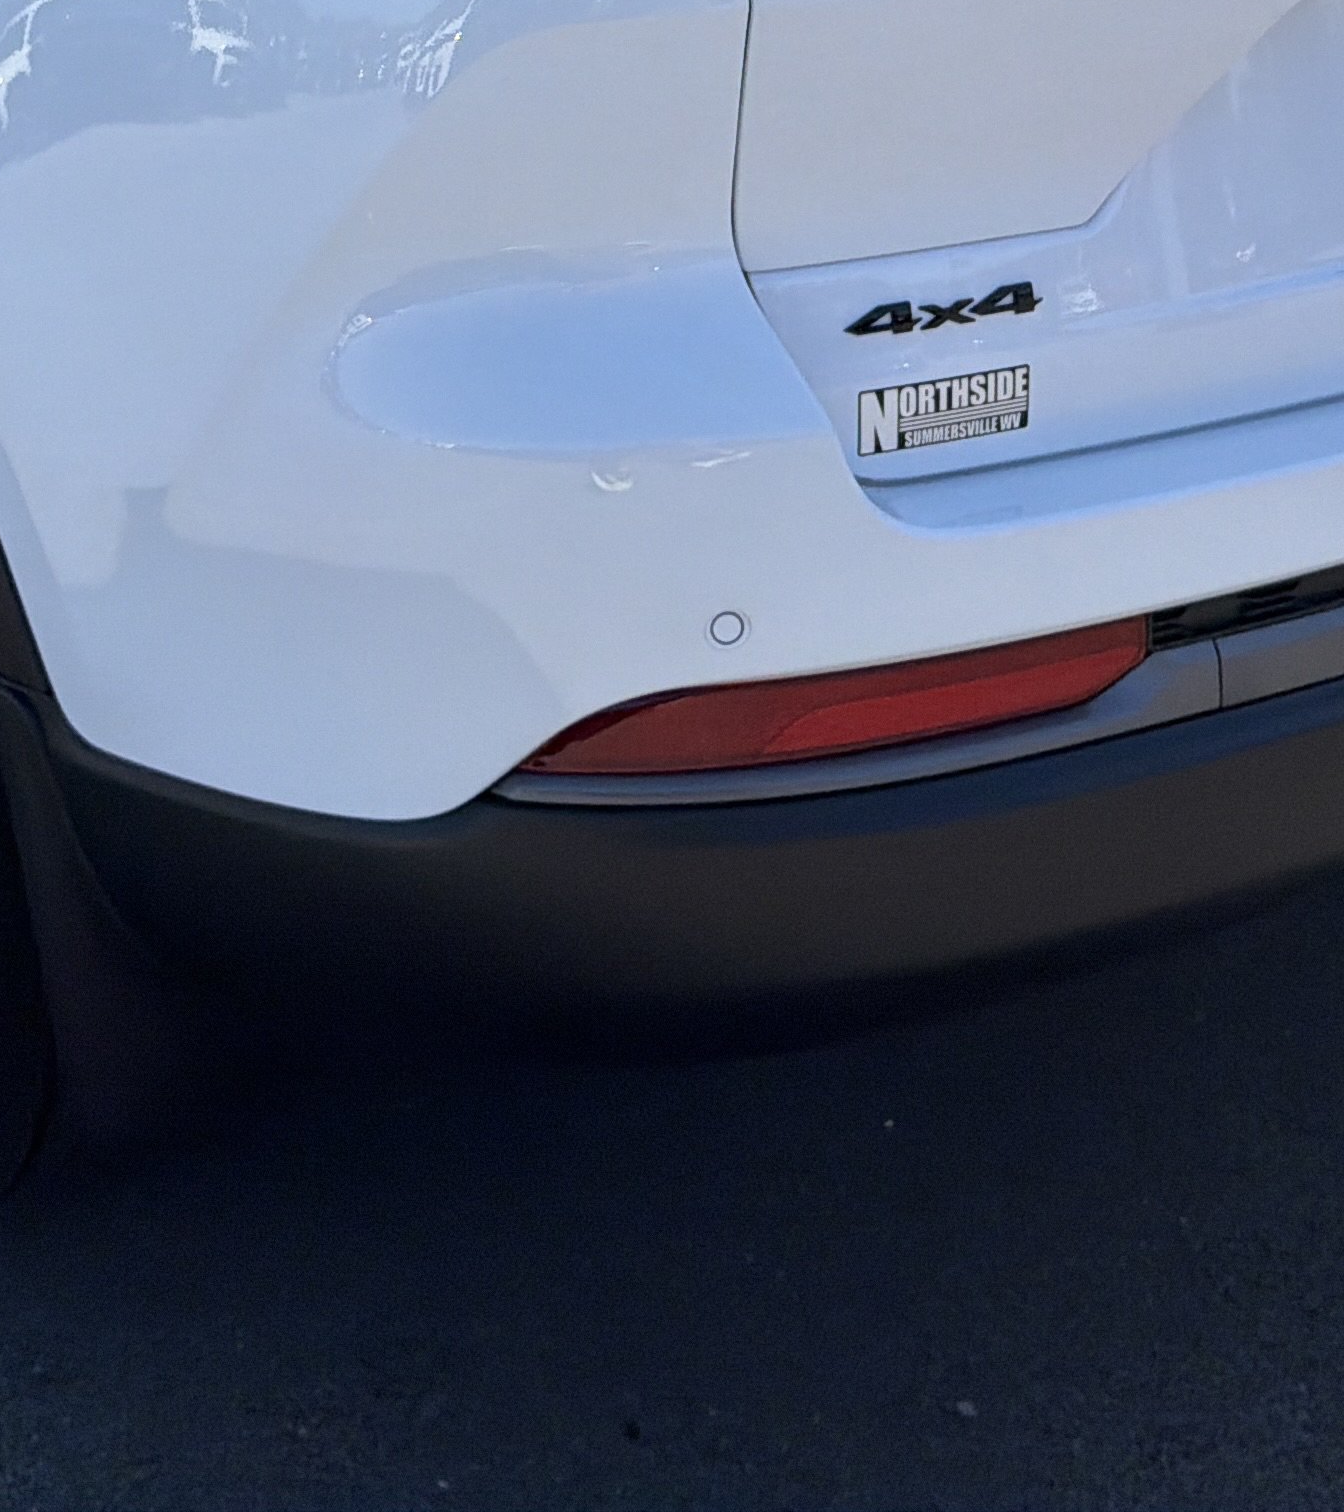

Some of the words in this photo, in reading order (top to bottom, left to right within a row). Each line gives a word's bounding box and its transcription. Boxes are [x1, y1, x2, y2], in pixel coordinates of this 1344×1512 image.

[843, 281, 1044, 335] 4x4
[859, 366, 1028, 455] NORTHSIDE
[903, 416, 999, 447] SUMMERSVILLE
[999, 411, 1022, 431] WV
